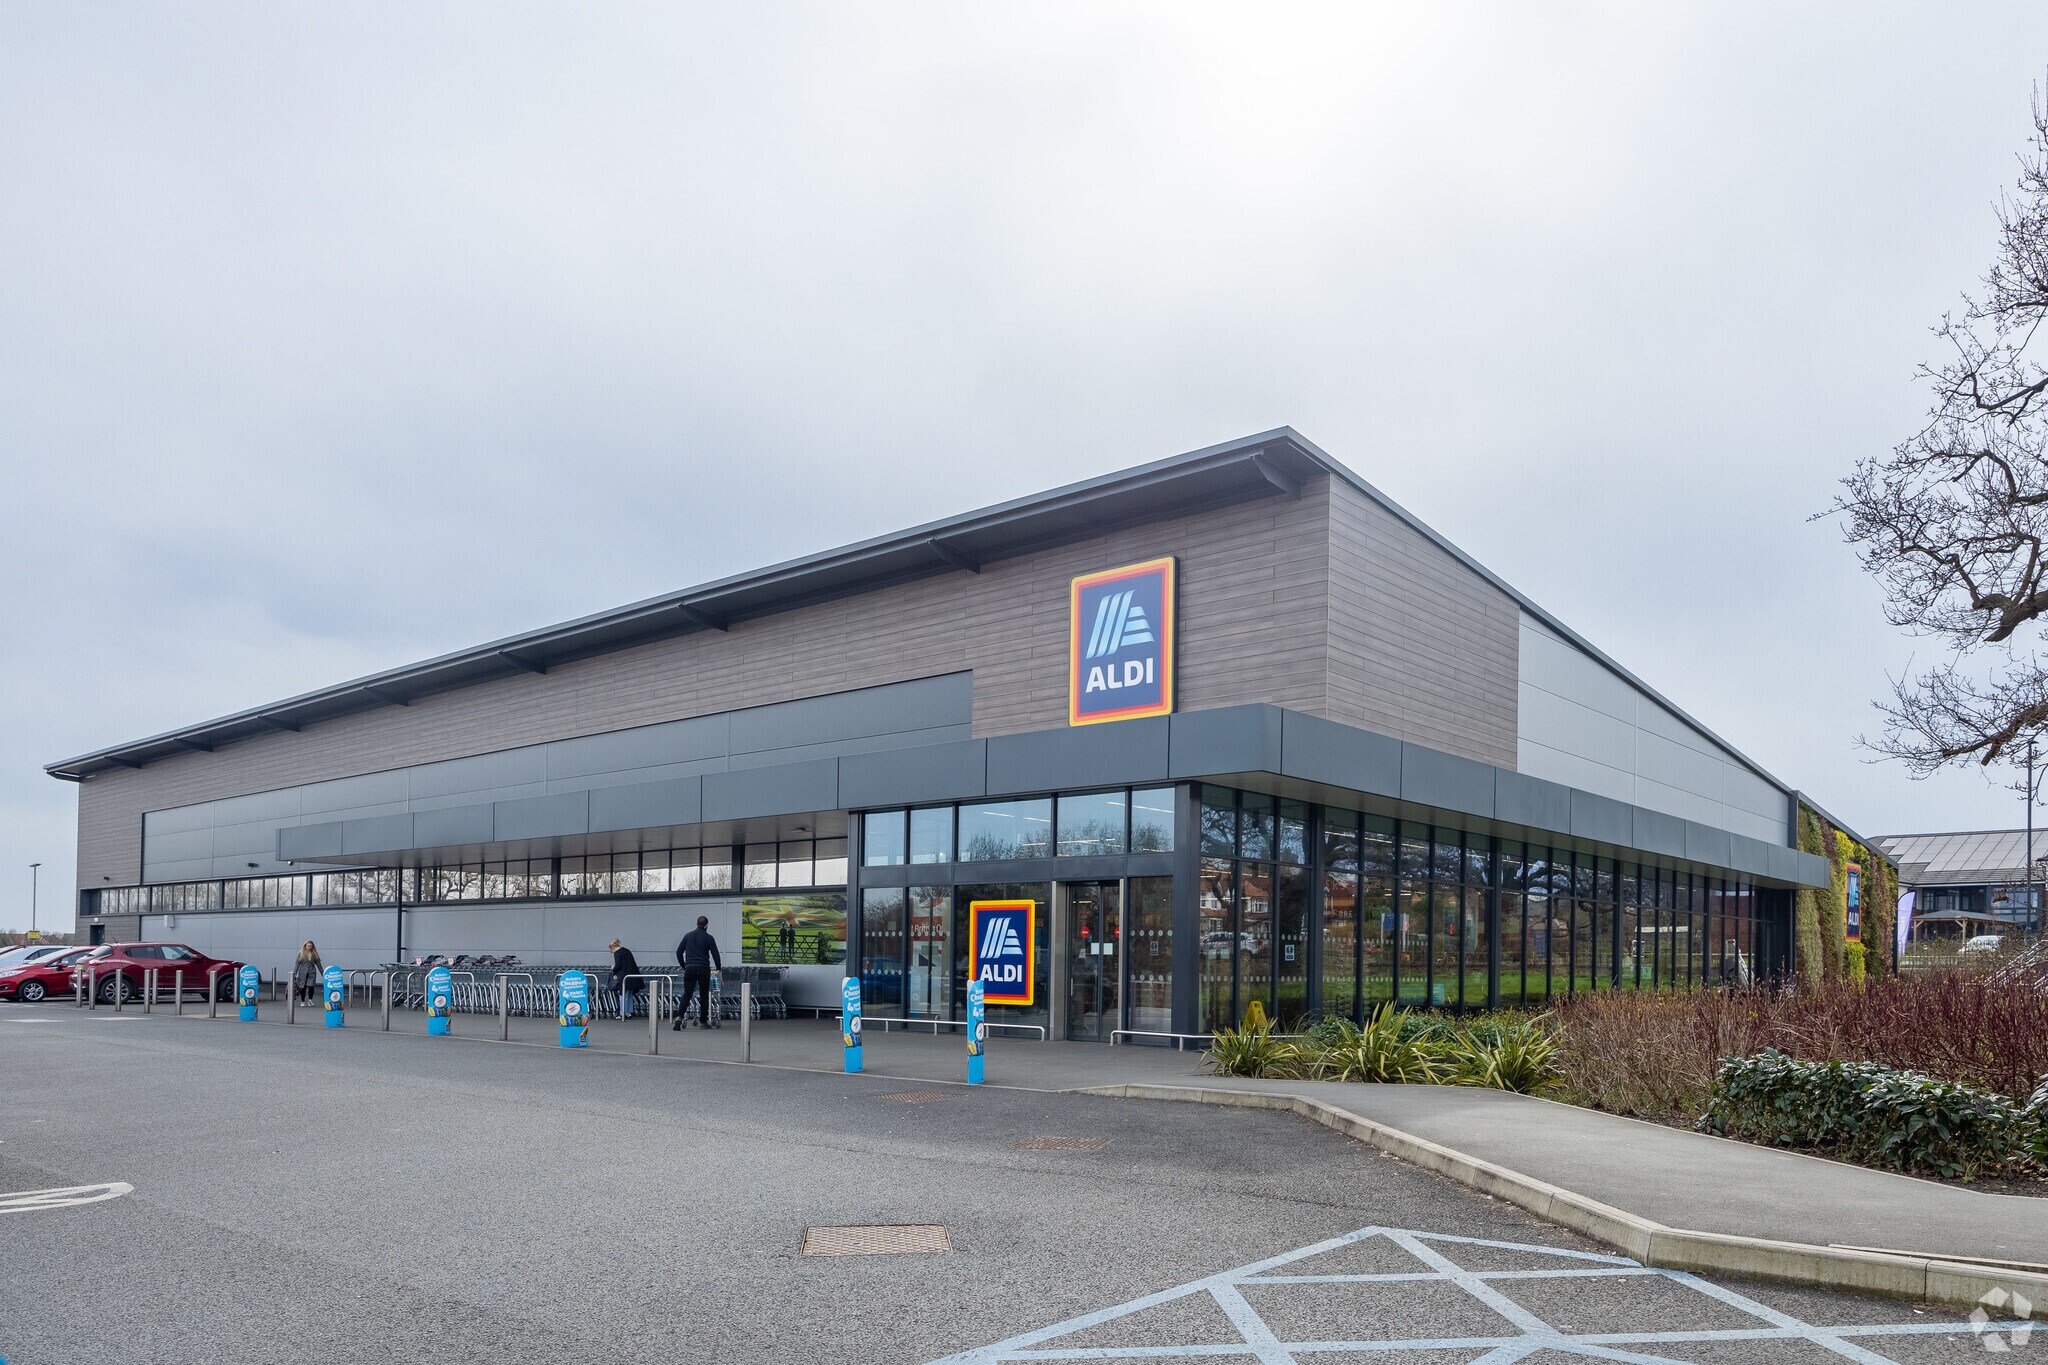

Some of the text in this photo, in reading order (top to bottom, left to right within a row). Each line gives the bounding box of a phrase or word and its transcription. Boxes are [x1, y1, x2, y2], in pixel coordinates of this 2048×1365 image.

[1085, 657, 1154, 694] ALDI
[1848, 911, 1860, 926] ALDI
[980, 964, 1023, 983] ALDI
